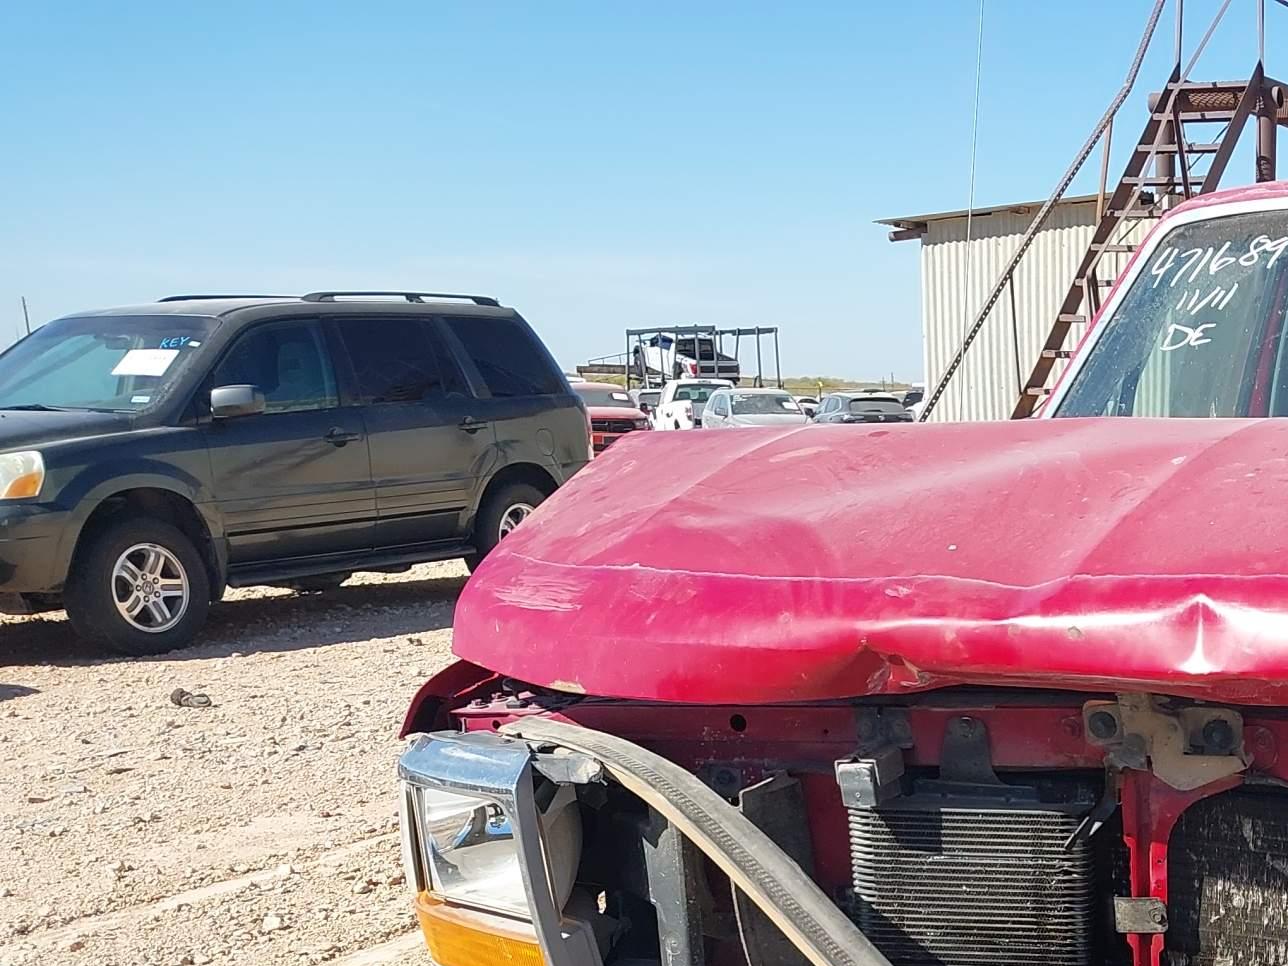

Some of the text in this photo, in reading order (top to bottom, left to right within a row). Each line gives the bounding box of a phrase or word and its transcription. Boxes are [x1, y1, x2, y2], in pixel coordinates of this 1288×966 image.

[1176, 282, 1239, 315] 11/11
[160, 336, 190, 348] KEY
[1160, 323, 1216, 351] DE
